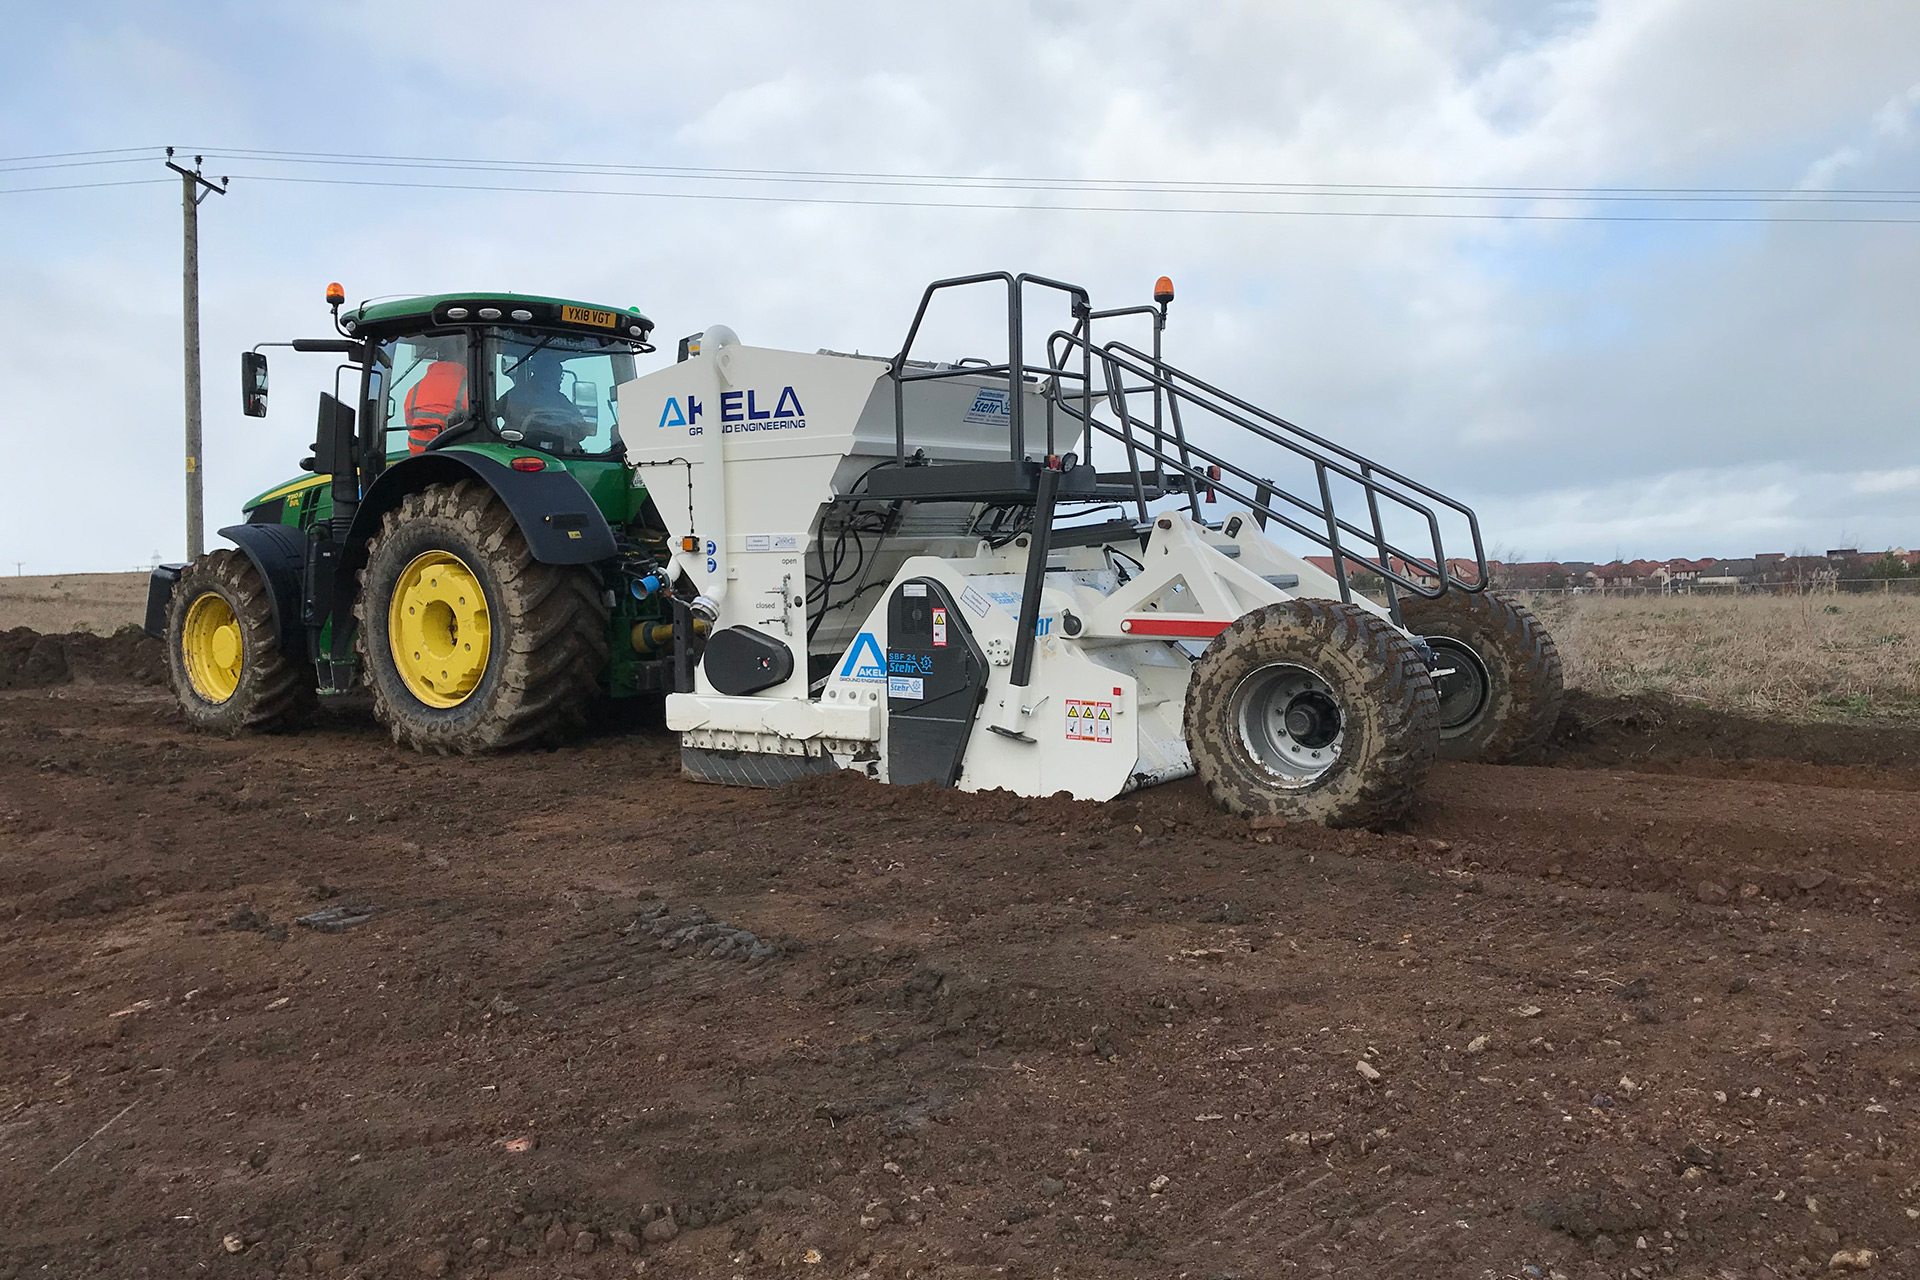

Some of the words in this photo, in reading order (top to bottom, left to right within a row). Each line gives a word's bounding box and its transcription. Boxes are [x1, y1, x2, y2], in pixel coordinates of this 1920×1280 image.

[569, 307, 590, 321] YX18
[592, 311, 611, 324] VGT
[971, 400, 1000, 414] Stehr
[689, 424, 733, 436] GRD
[734, 419, 806, 433] ENGINEERING
[782, 557, 797, 565] open
[889, 652, 905, 660] SBF
[889, 662, 917, 673] Stehr
[890, 683, 910, 692] Stehr
